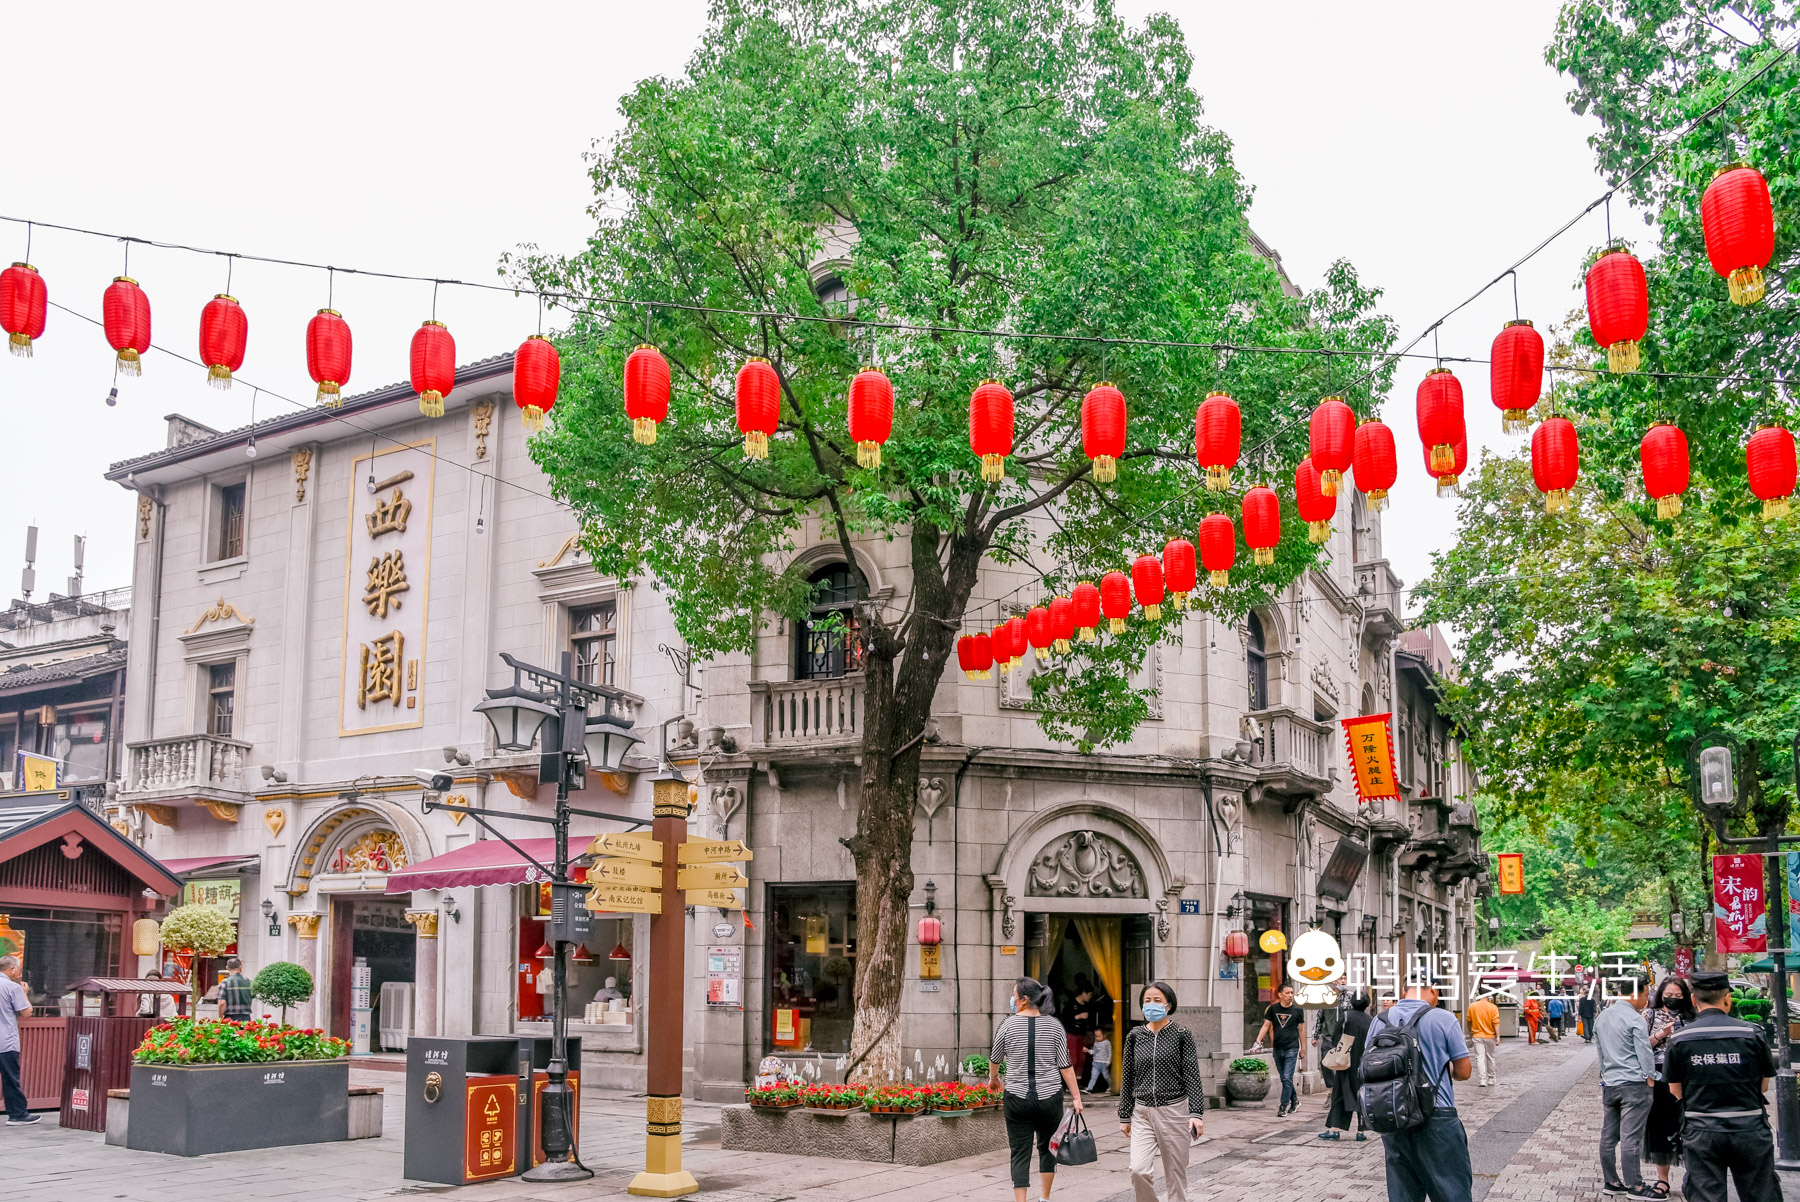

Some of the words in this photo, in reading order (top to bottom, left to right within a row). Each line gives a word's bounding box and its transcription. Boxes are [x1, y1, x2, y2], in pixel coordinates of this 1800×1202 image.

[357, 469, 414, 711] 西樂園
[1361, 733, 1384, 785] 万隆火腿庄
[704, 845, 731, 855] 中河中路
[332, 845, 388, 872] 小吃
[612, 866, 626, 876] 鼓楼
[714, 872, 727, 881] 厕所
[204, 884, 240, 914] 糖葫芦
[608, 894, 645, 905] 南宋记忆馆
[1185, 905, 1195, 913] 79
[1690, 1053, 1741, 1066] 安保集团
